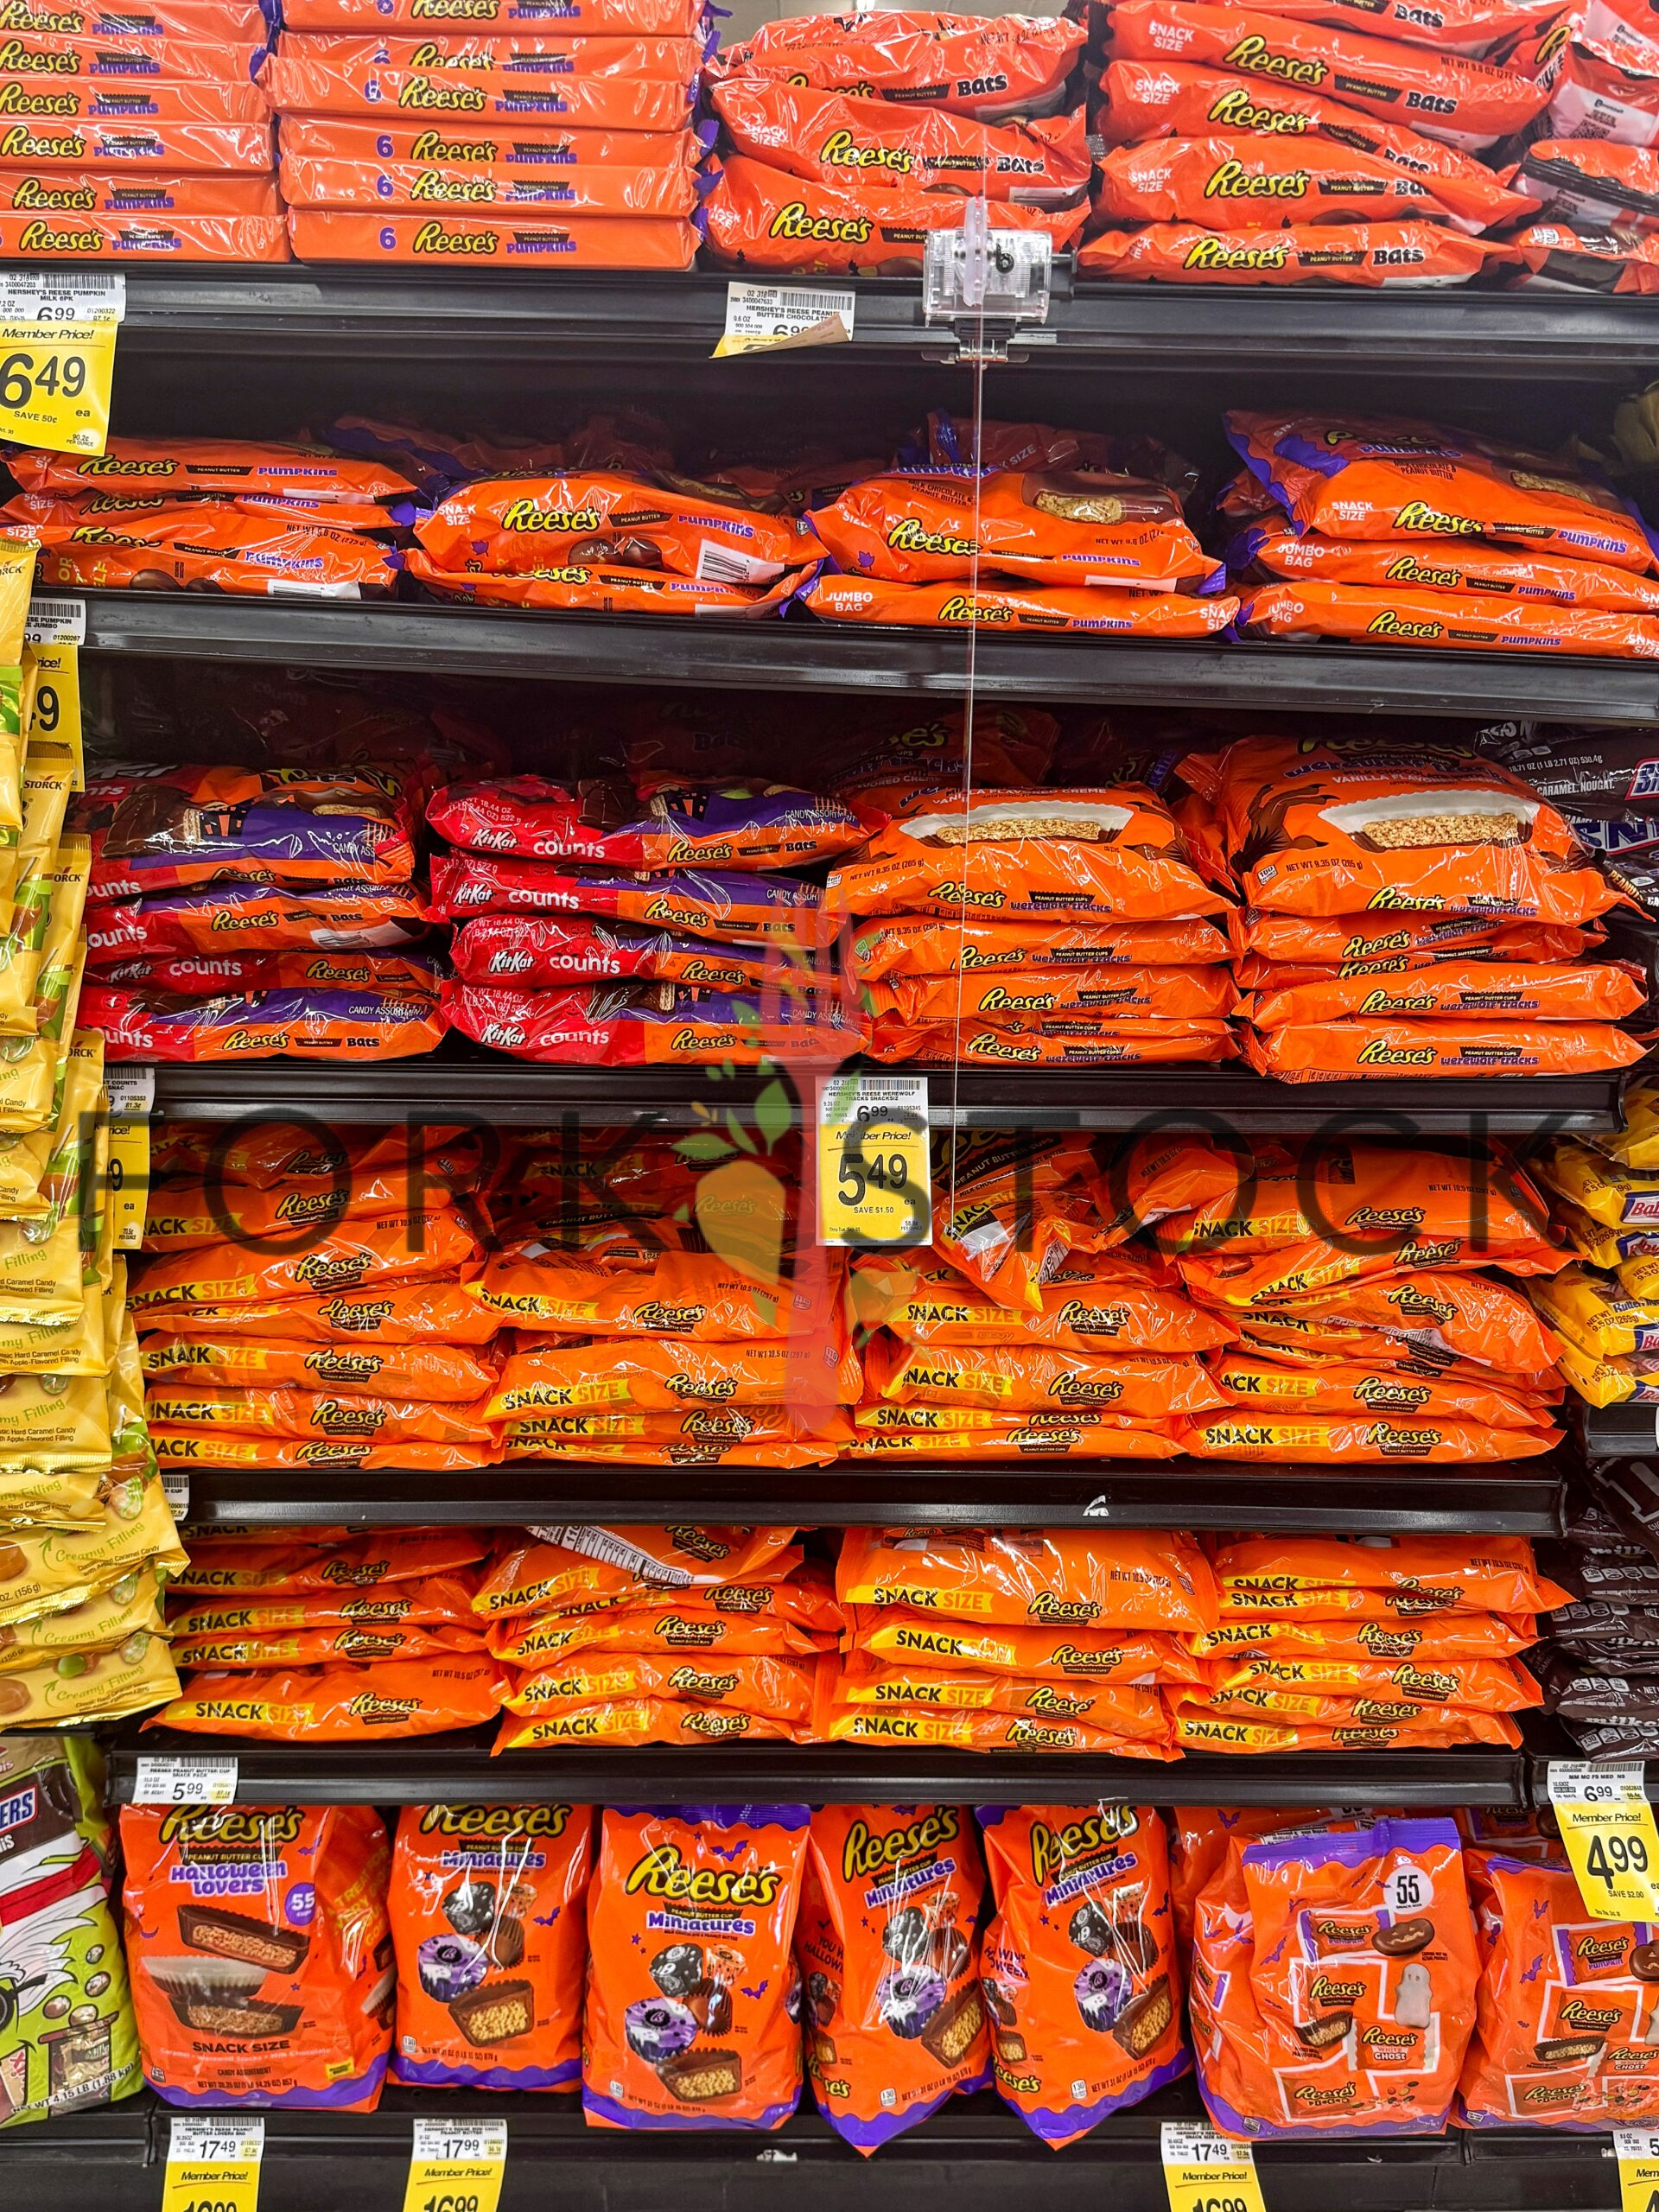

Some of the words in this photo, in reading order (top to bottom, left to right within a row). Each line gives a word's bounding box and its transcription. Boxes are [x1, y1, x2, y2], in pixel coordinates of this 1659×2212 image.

[1154, 35, 1183, 52] SIZE
[0, 40, 81, 74] Reese's
[1224, 35, 1329, 88] Reese's
[398, 77, 487, 111] Reese's
[377, 136, 394, 156] 6
[410, 131, 499, 162] Reese's
[1137, 180, 1163, 192] SIZE
[1205, 159, 1309, 199] Reese's
[12, 178, 95, 211] Reese's
[769, 202, 874, 243] Reese's
[379, 227, 396, 249] 6
[413, 221, 500, 254] Reese's
[1184, 238, 1289, 271] Reese's
[747, 305, 785, 314] HERSHEY'S
[2, 328, 57, 339] Member
[59, 330, 94, 340] Price!
[14, 410, 40, 421] SAVE
[42, 415, 57, 423] 50¢
[78, 454, 178, 476] Reese's
[502, 499, 601, 533] Reese's
[1332, 501, 1374, 511] SNACK
[1339, 510, 1365, 521] SIZE
[1277, 544, 1325, 558] JUMBO
[1285, 556, 1313, 568] BAG
[1386, 557, 1462, 588] Reese's
[826, 591, 873, 603] JUMBO
[836, 602, 863, 612] BAG
[939, 595, 1012, 622] Reese's
[1367, 611, 1444, 639] Reese's
[1554, 758, 1567, 767] 2.71
[1568, 757, 1580, 766] OZ)
[1580, 755, 1603, 764] 530.4g
[23, 780, 63, 790] STORCK
[667, 842, 734, 865] Reese's
[849, 871, 862, 881] NET
[864, 869, 874, 878] WT
[891, 863, 900, 873] OZ
[680, 961, 746, 984] Reese's
[978, 988, 1056, 1012] Reese's
[1359, 989, 1437, 1014] Reese's
[671, 1029, 736, 1051] Reese's
[1357, 1040, 1437, 1065] Reese's
[857, 1105, 888, 1122] 699
[882, 1131, 912, 1140] Price!
[838, 1154, 907, 1205] 549
[954, 1160, 990, 1188] PEANUT
[4, 1248, 48, 1270] Filling
[908, 1304, 969, 1322] SNACK
[975, 1308, 1014, 1323] SIZE
[1586, 1319, 1599, 1328] NET
[1599, 1310, 1611, 1319] WT
[148, 1349, 210, 1370] SNACK
[505, 1387, 574, 1410] SNACK
[577, 1382, 621, 1402] SIZE
[55, 1434, 74, 1443] Filling
[1205, 1427, 1273, 1445] SNACK
[1279, 1427, 1319, 1444] SIZE
[55, 1548, 105, 1562] Creamy
[106, 1521, 145, 1547] Filling
[874, 1587, 938, 1607] SNACK
[943, 1594, 983, 1611] SIZE
[896, 1630, 963, 1656] SNACK
[1249, 1662, 1306, 1681] SNACK
[1311, 1665, 1349, 1681] SIZE
[195, 1702, 264, 1720] SNACK
[532, 1716, 600, 1740] SNACK
[173, 1783, 203, 1800] 599
[1573, 1814, 1612, 1822] Member
[1615, 1813, 1641, 1821] Price!
[1587, 1835, 1649, 1889] 499
[625, 1844, 783, 1905] Reese's
[1396, 1874, 1421, 1905] 55
[289, 1891, 315, 1910] 55
[671, 1907, 695, 1916] PEANUT
[1577, 1936, 1629, 1957] Reese's
[1311, 1978, 1367, 1999] Reese's
[193, 2040, 247, 2054] SNACK
[251, 2039, 290, 2051] SIZE
[1374, 2050, 1407, 2061] GHOST
[53, 2088, 76, 2104] 4.15
[76, 2083, 90, 2094] LB
[1192, 2144, 1227, 2161] 1749
